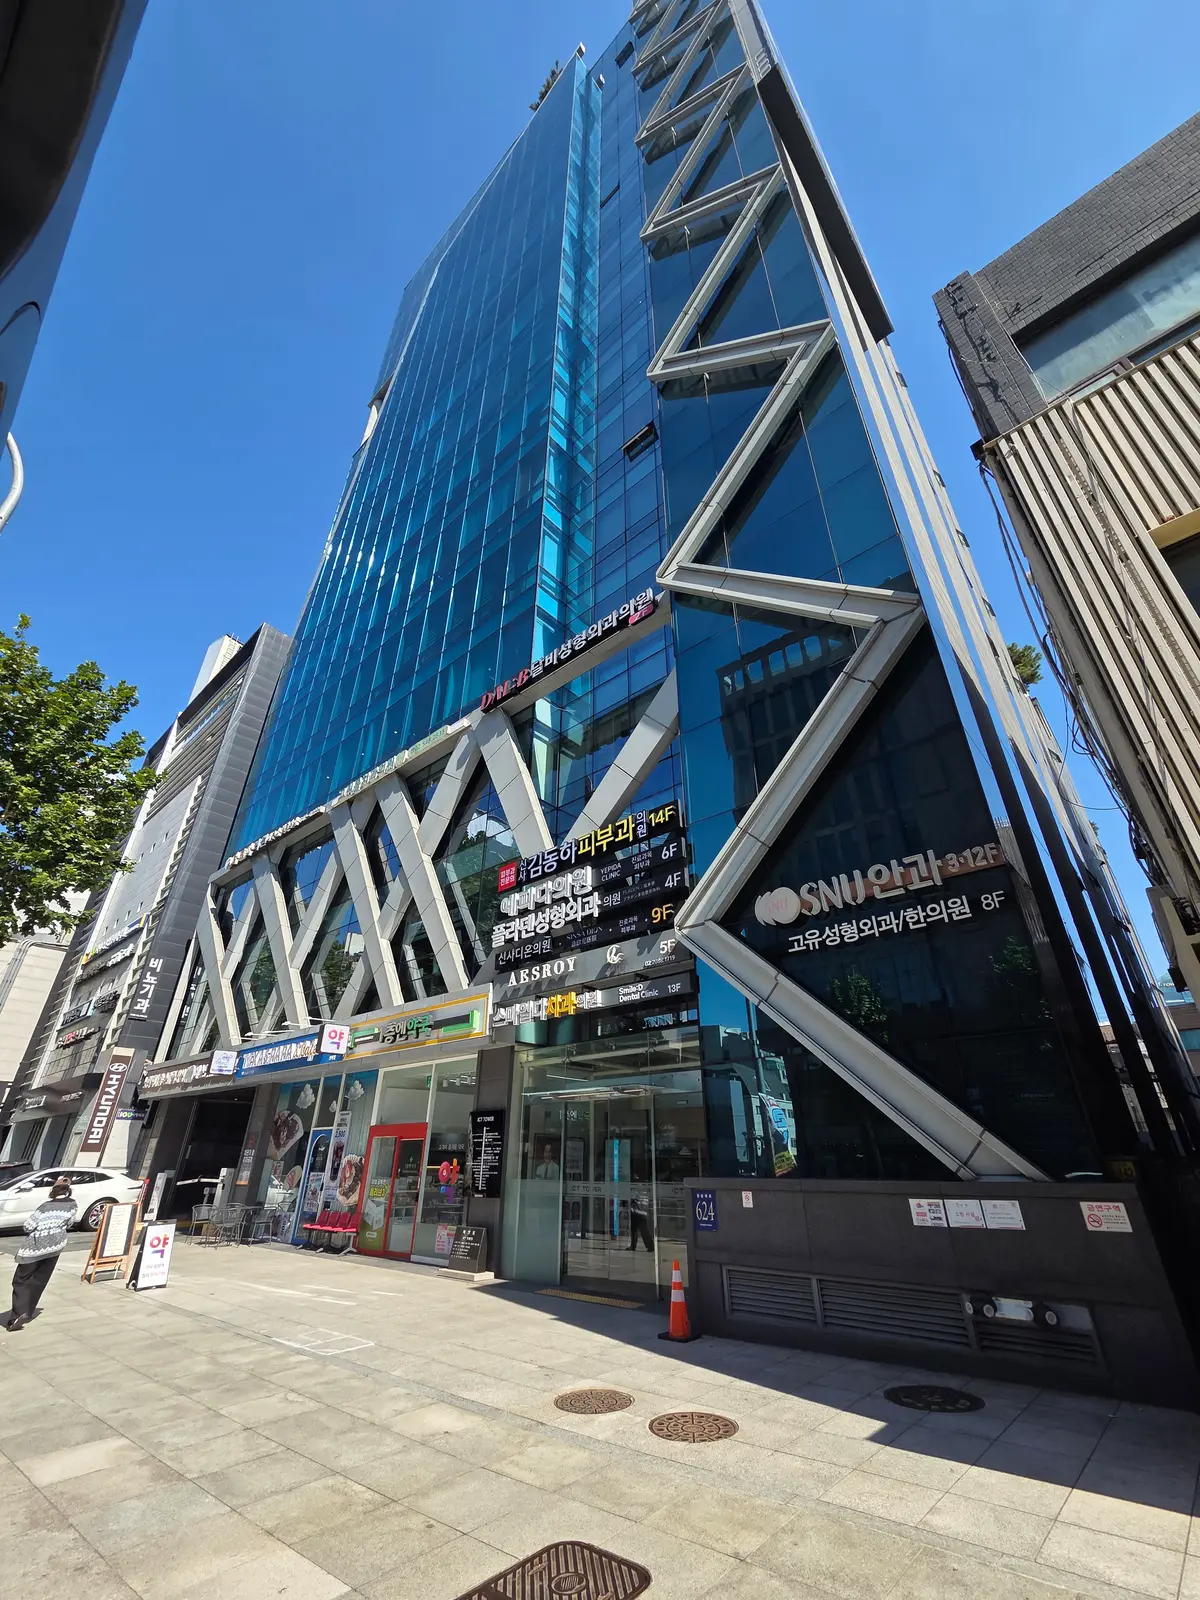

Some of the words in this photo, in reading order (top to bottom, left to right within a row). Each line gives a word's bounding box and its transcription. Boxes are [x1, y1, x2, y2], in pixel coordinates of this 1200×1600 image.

[530, 587, 654, 678] 달비성형외과의원
[648, 806, 674, 828] 14F
[661, 842, 678, 860] 6F
[600, 862, 622, 875] YEPIDA
[601, 870, 621, 881] CLINIC
[664, 872, 682, 888] 4F
[799, 850, 943, 916] SNU안과
[500, 865, 593, 917] 예피다의원
[491, 891, 602, 948] 플라덴성형외과
[603, 892, 621, 907] 의원
[651, 904, 675, 924] 9F
[788, 895, 973, 953] 고유성형외과/한의원
[980, 891, 1006, 911] 8F
[498, 938, 552, 965] 신사디온의원
[659, 939, 676, 954] 5F
[507, 956, 577, 987] AESROY
[133, 957, 164, 1014] 비뇨기과
[619, 994, 641, 1003] Dental
[641, 989, 659, 999] Clinic
[667, 983, 682, 994] 13F
[328, 1029, 345, 1050] 약
[87, 1074, 122, 1144] HYUNDAI
[695, 1200, 715, 1221] 624
[1086, 1204, 1122, 1213] 금연구역
[149, 1233, 169, 1259] 약
